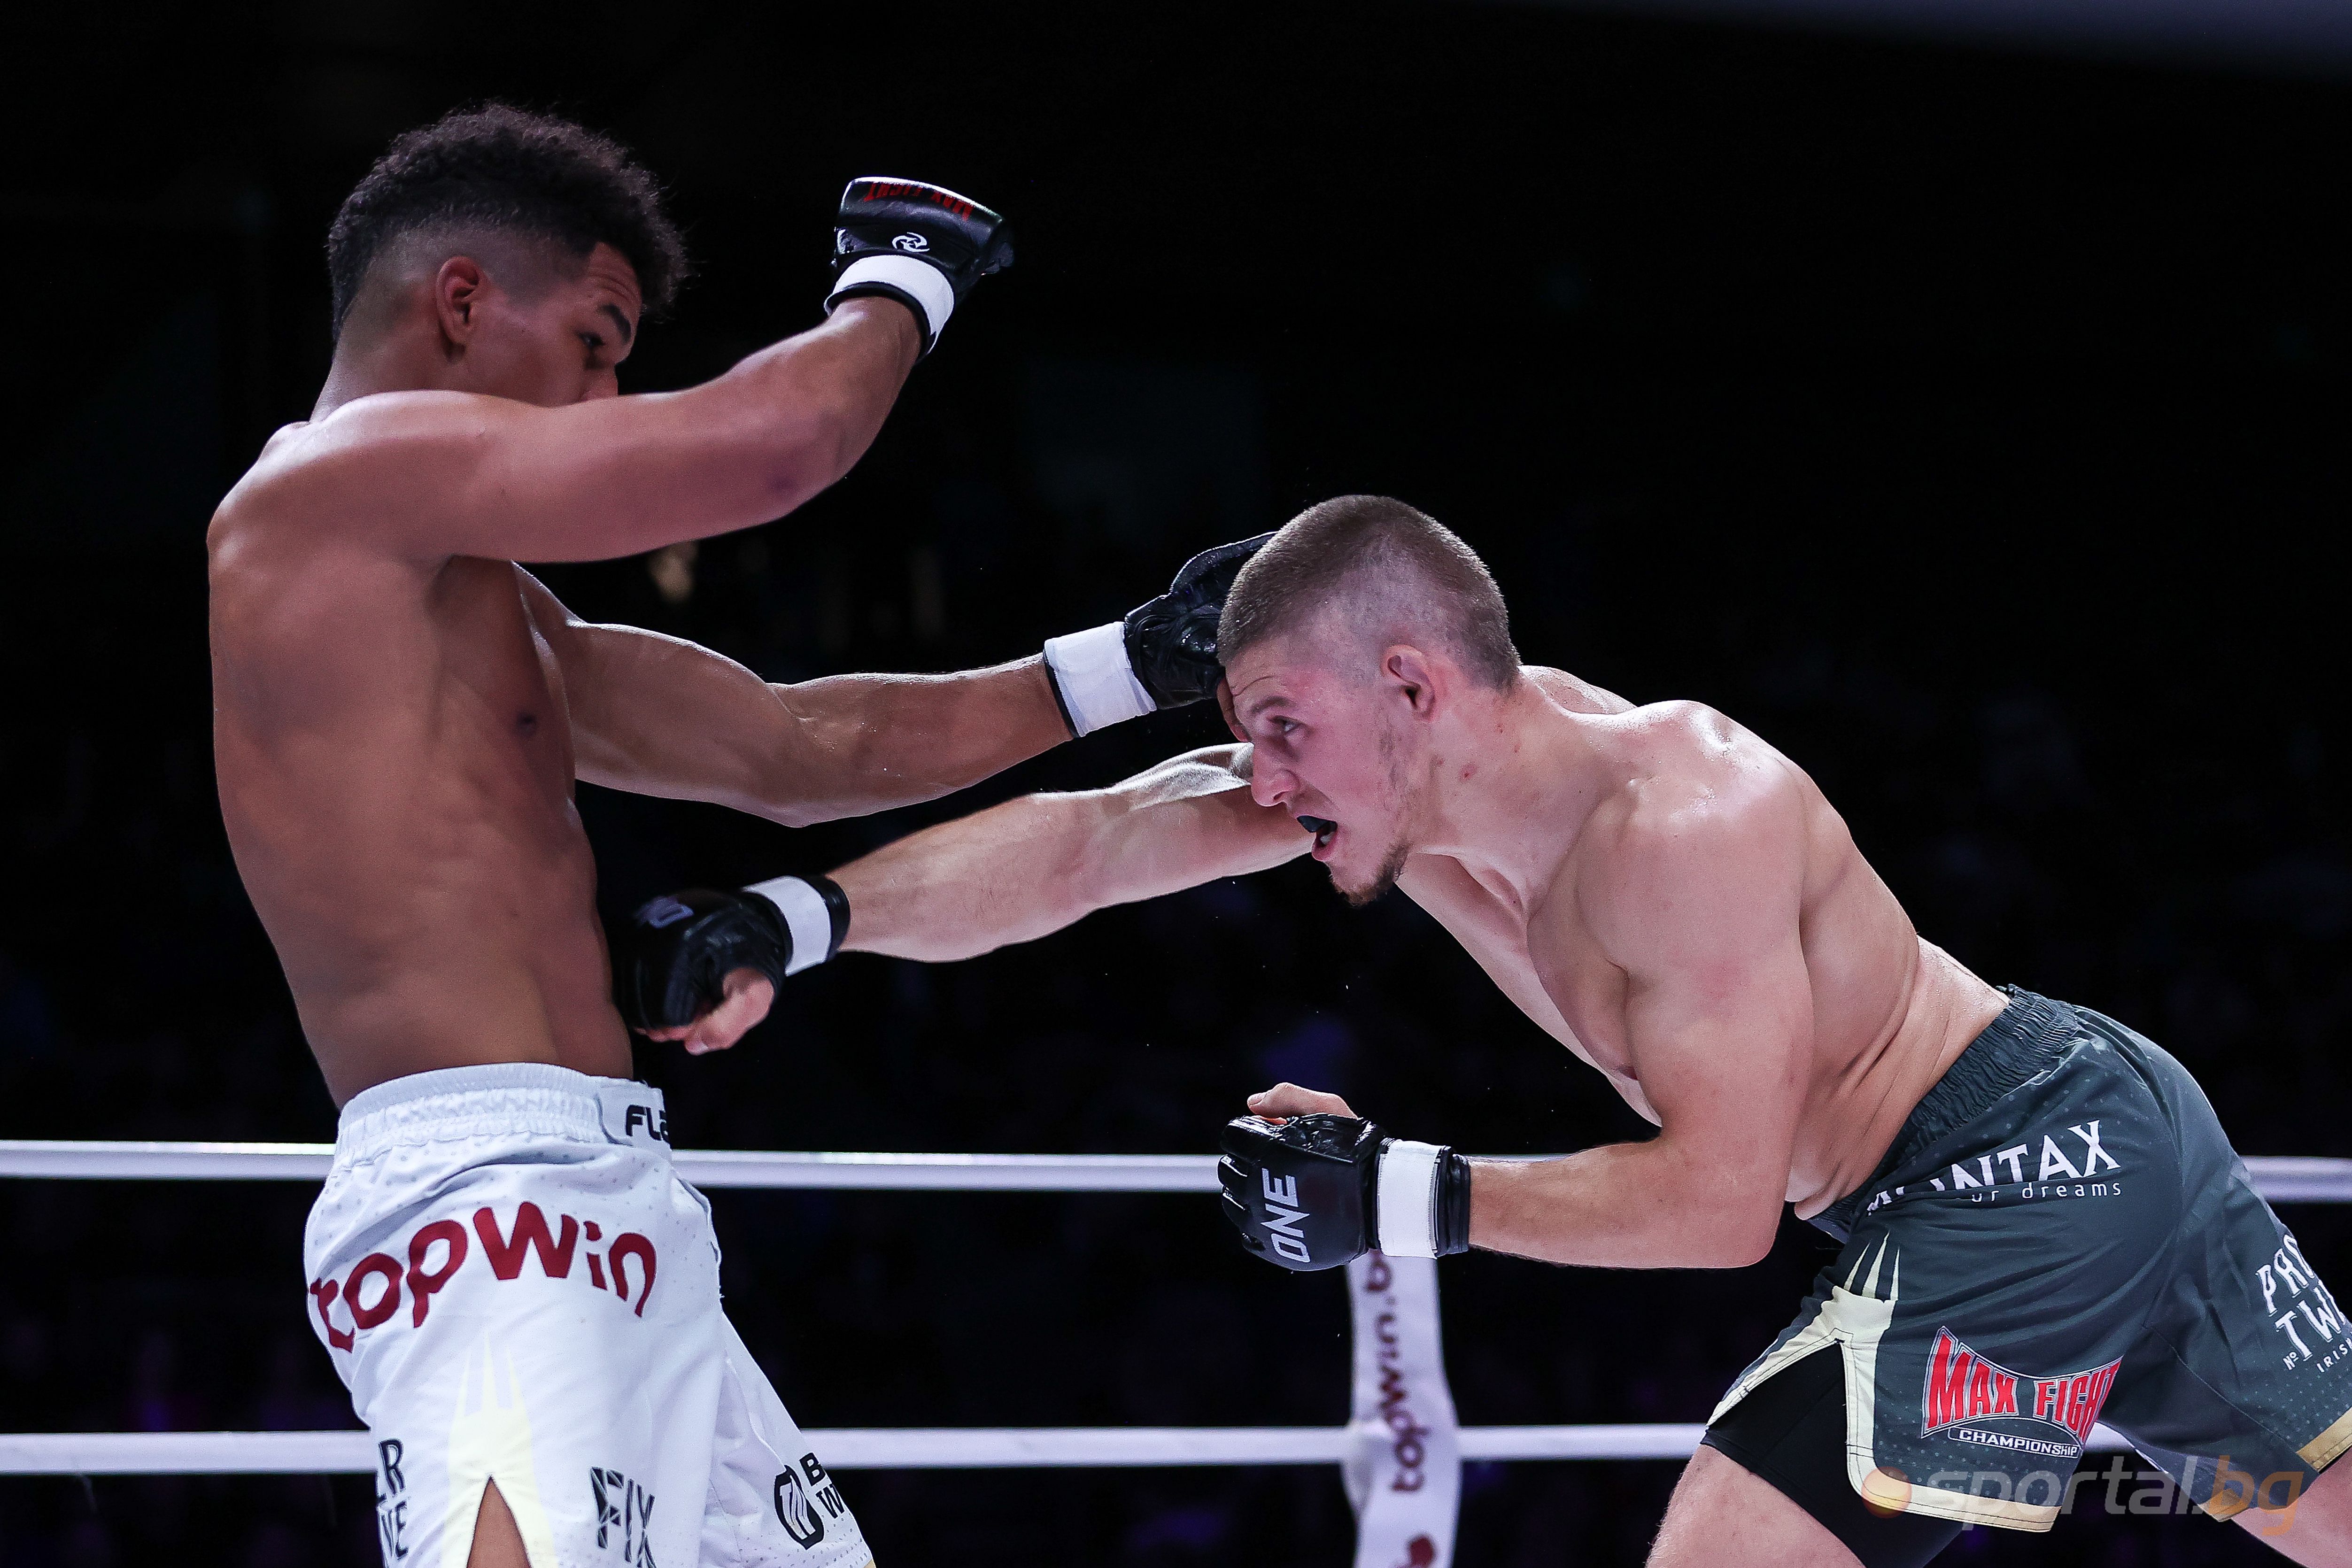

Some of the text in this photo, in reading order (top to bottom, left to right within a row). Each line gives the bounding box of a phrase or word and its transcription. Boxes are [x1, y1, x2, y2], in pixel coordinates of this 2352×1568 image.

[1260, 1168, 1311, 1263] ONE
[2022, 1181, 2122, 1199] dreams
[1924, 1329, 2019, 1433] MAX
[1958, 1428, 2079, 1457] CHAMPIONSHIP
